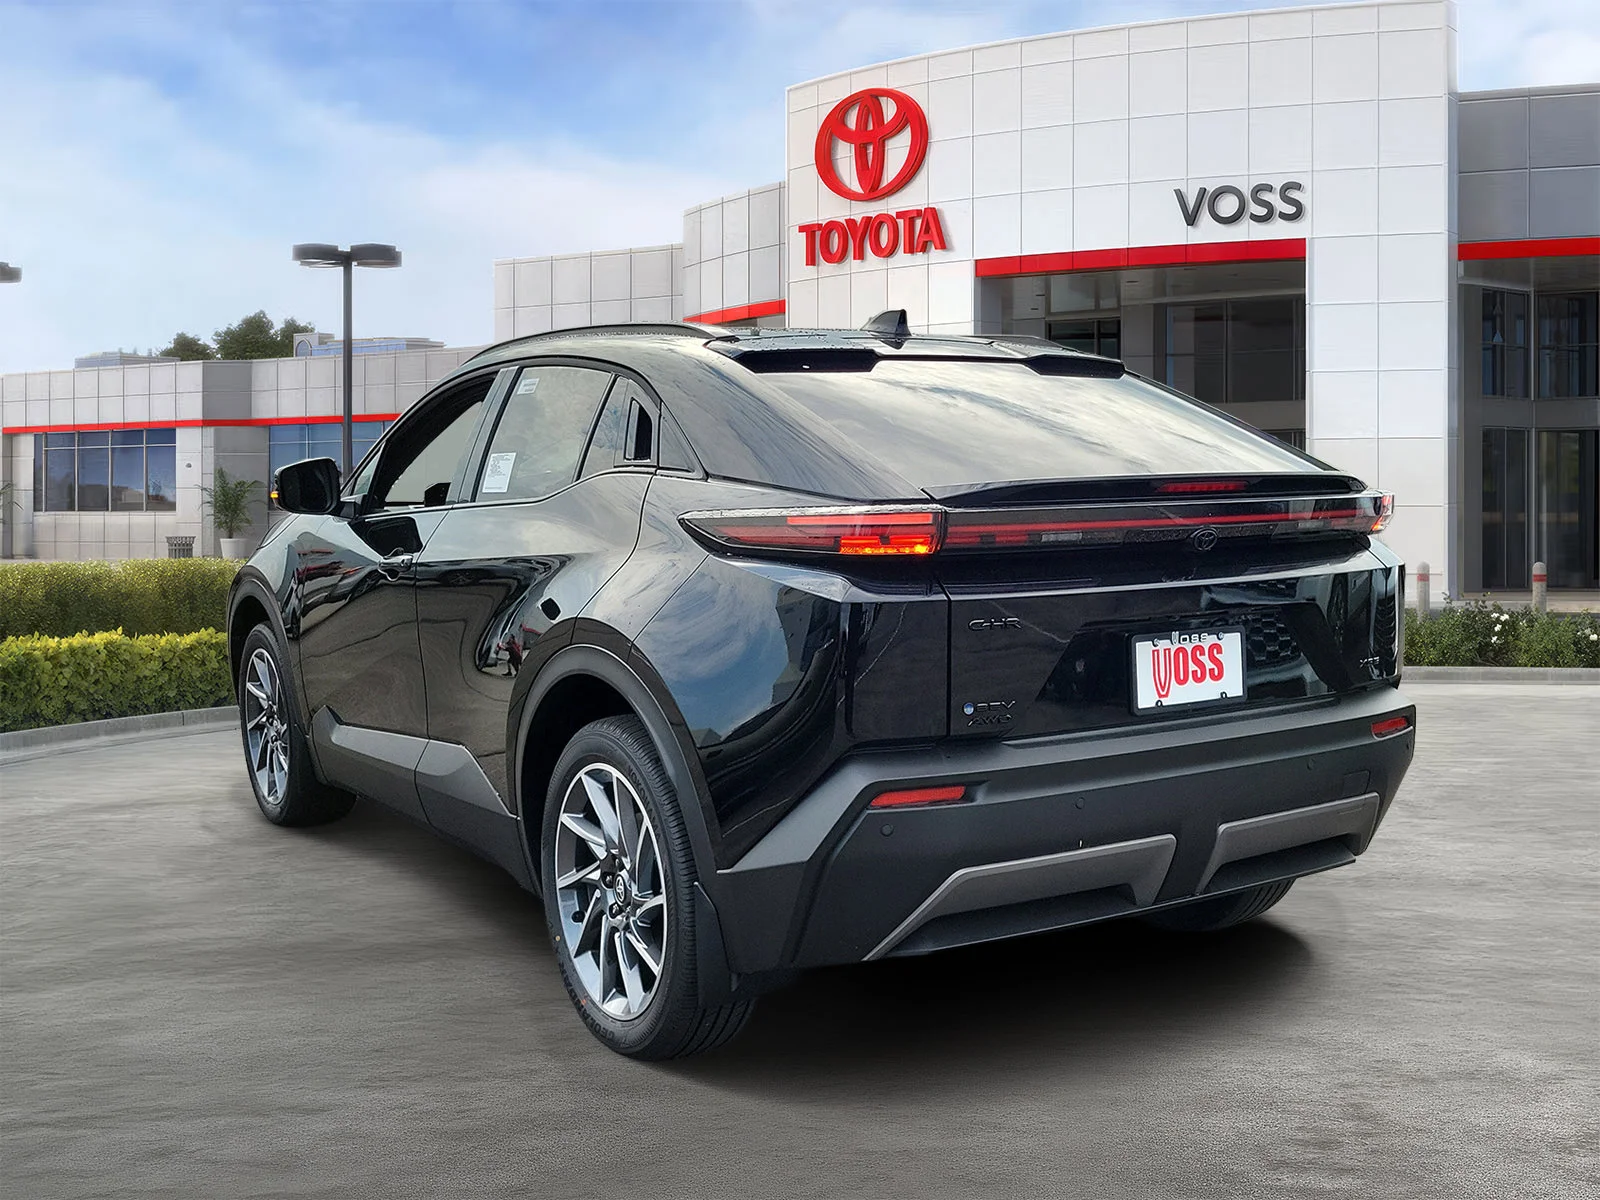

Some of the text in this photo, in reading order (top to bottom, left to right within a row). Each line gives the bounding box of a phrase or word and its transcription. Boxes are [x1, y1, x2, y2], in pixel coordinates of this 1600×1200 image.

[1174, 181, 1304, 226] VOSS
[798, 207, 947, 266] TOYOTA
[1151, 643, 1225, 699] VOSS
